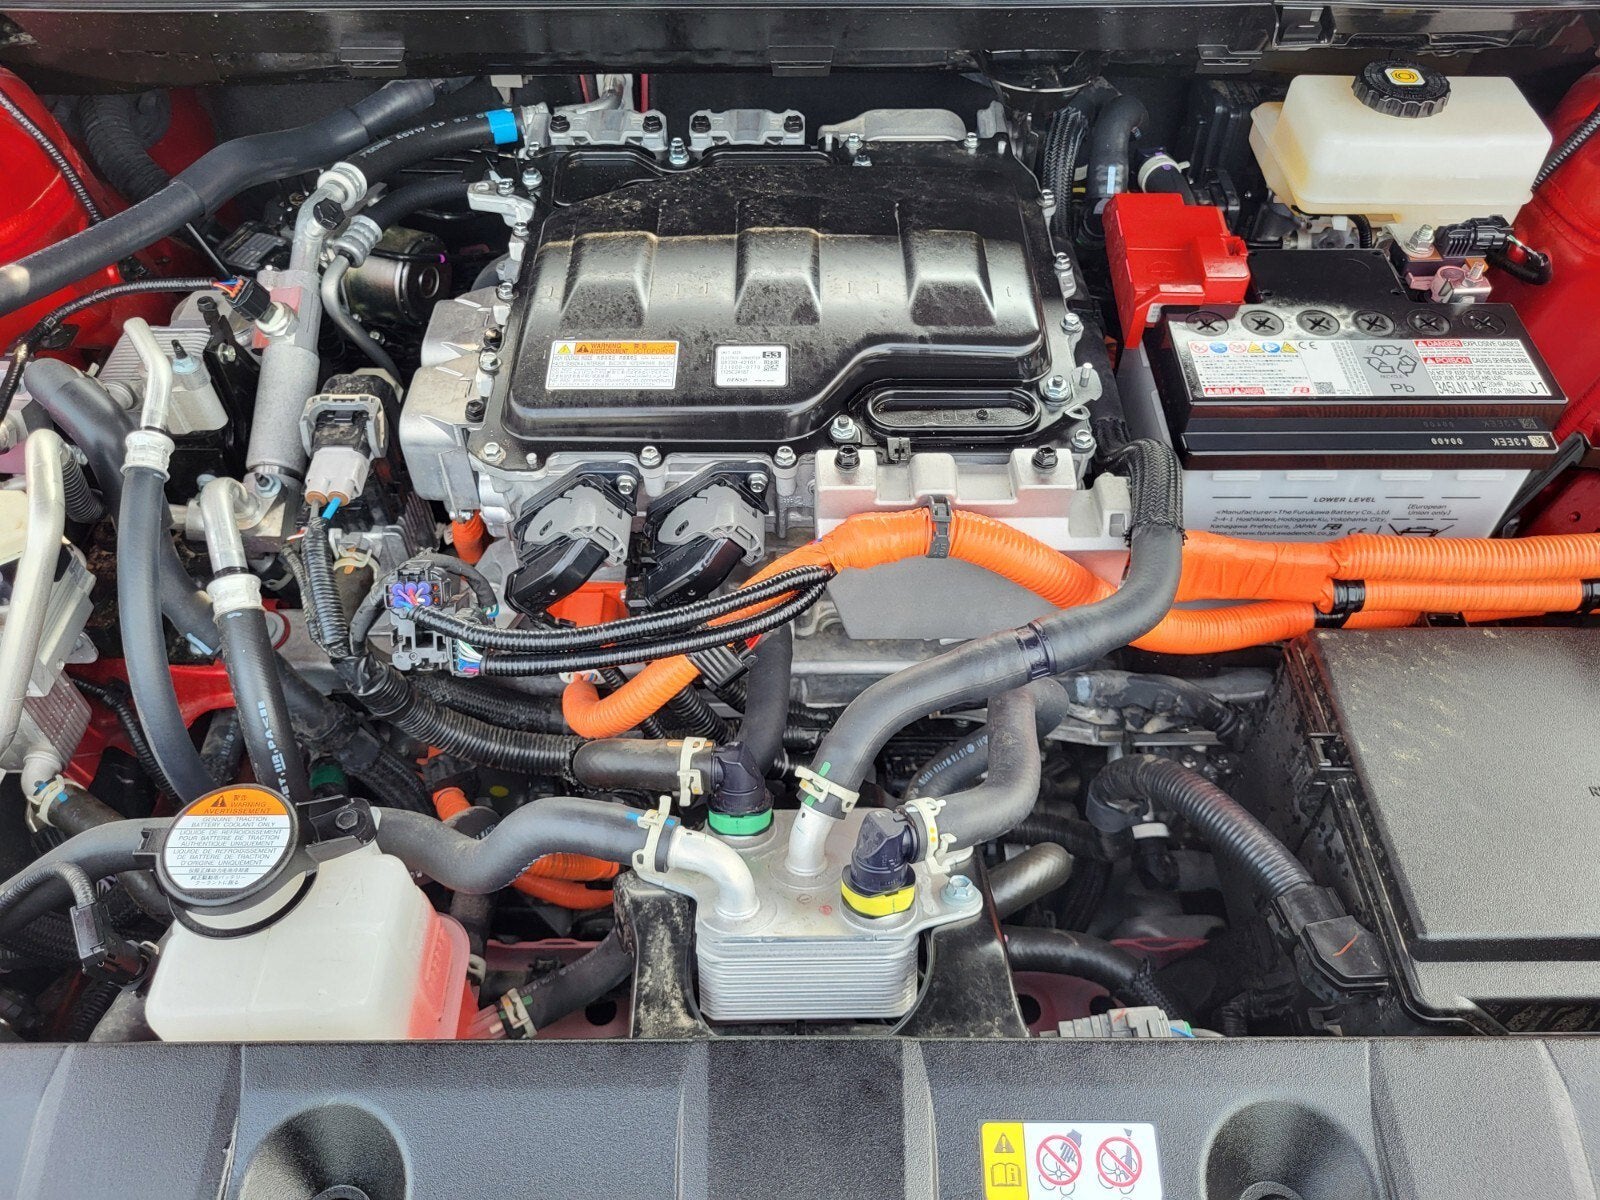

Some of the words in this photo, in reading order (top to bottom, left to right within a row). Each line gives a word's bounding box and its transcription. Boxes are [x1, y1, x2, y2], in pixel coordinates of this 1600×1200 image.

[1390, 384, 1415, 392] Pb
[1436, 382, 1488, 395] 345LN1-MF
[1431, 437, 1463, 445] 00400
[1491, 437, 1528, 446] 43EEK
